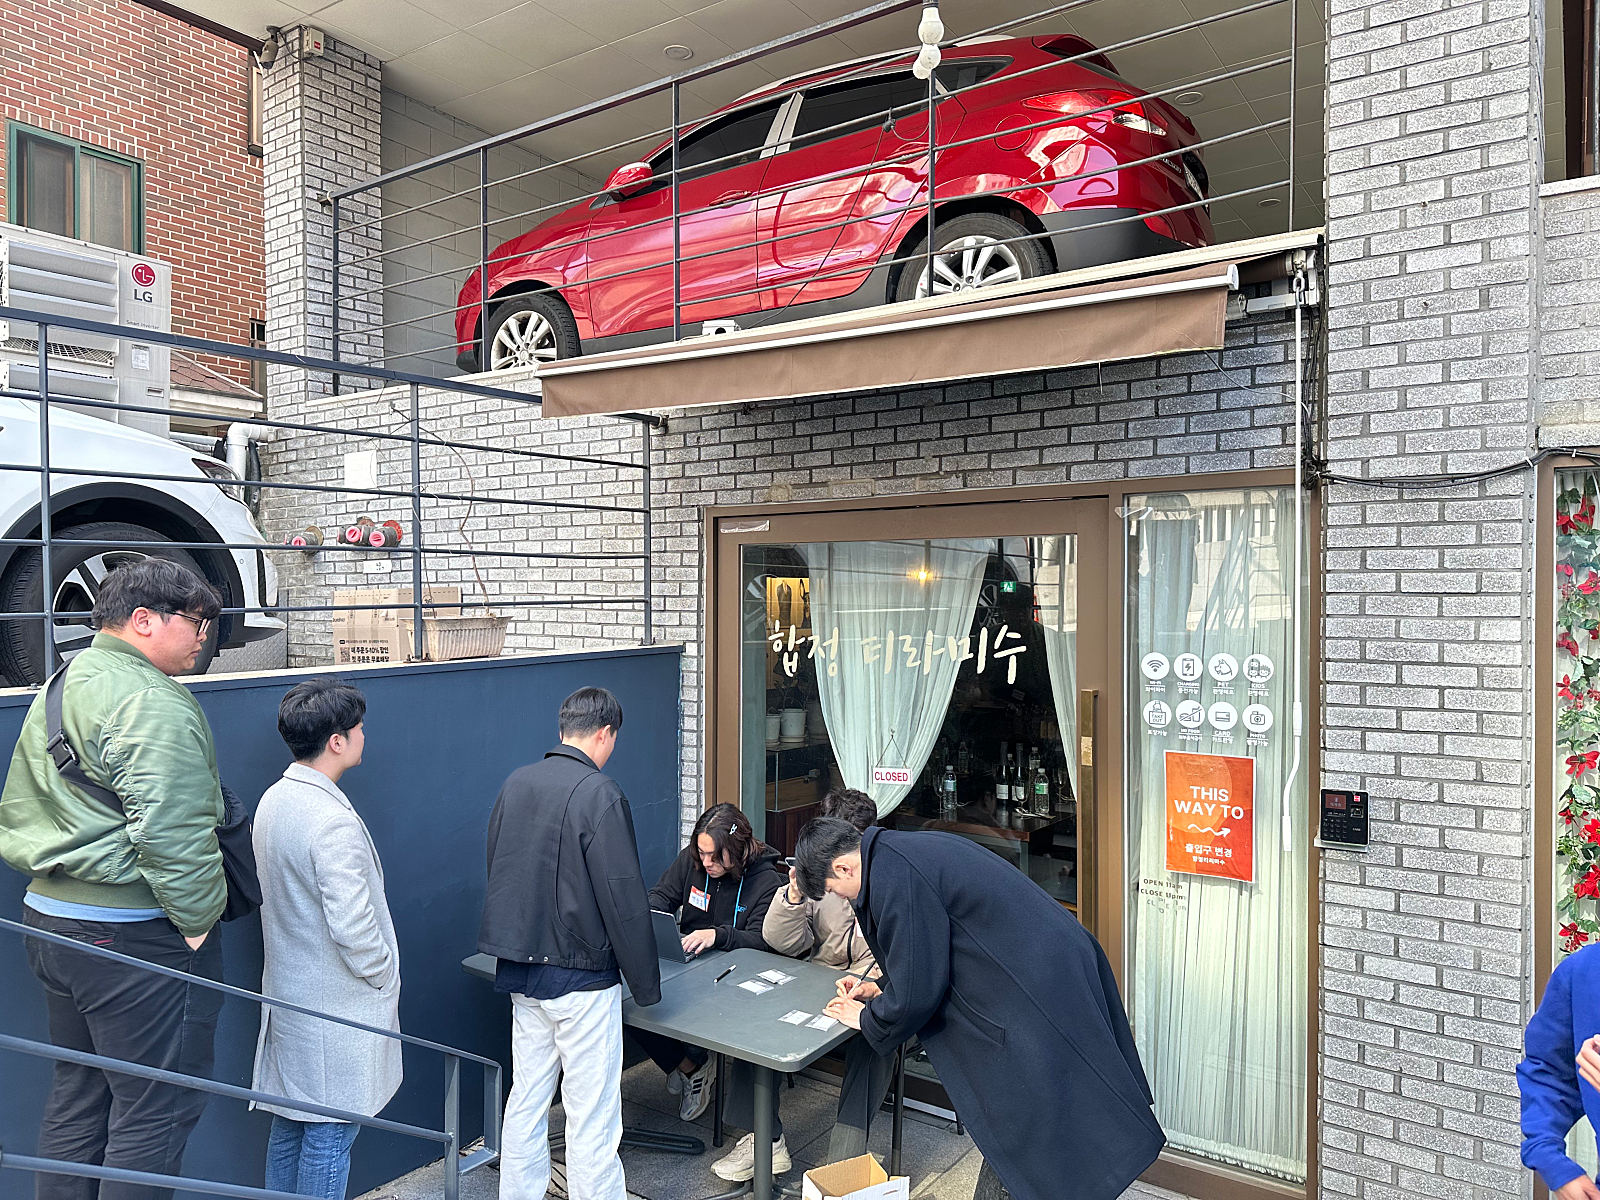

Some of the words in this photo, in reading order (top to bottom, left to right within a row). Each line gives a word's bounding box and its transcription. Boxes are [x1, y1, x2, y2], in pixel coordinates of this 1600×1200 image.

[134, 289, 153, 303] LG
[126, 319, 140, 327] Smart
[141, 322, 160, 330] Inverter
[768, 620, 838, 677] 합정
[862, 624, 1027, 684] 티라미수
[874, 771, 909, 782] CLOSED
[1190, 785, 1229, 802] THIS
[1174, 799, 1216, 816] WAY
[1220, 804, 1244, 820] TO
[1185, 843, 1212, 855] 출입구
[1214, 846, 1233, 858] 변경
[1143, 878, 1164, 887] OPEN
[1165, 881, 1183, 890] 11am
[1140, 888, 1164, 897] CLOSE
[1165, 892, 1183, 900] 11pm
